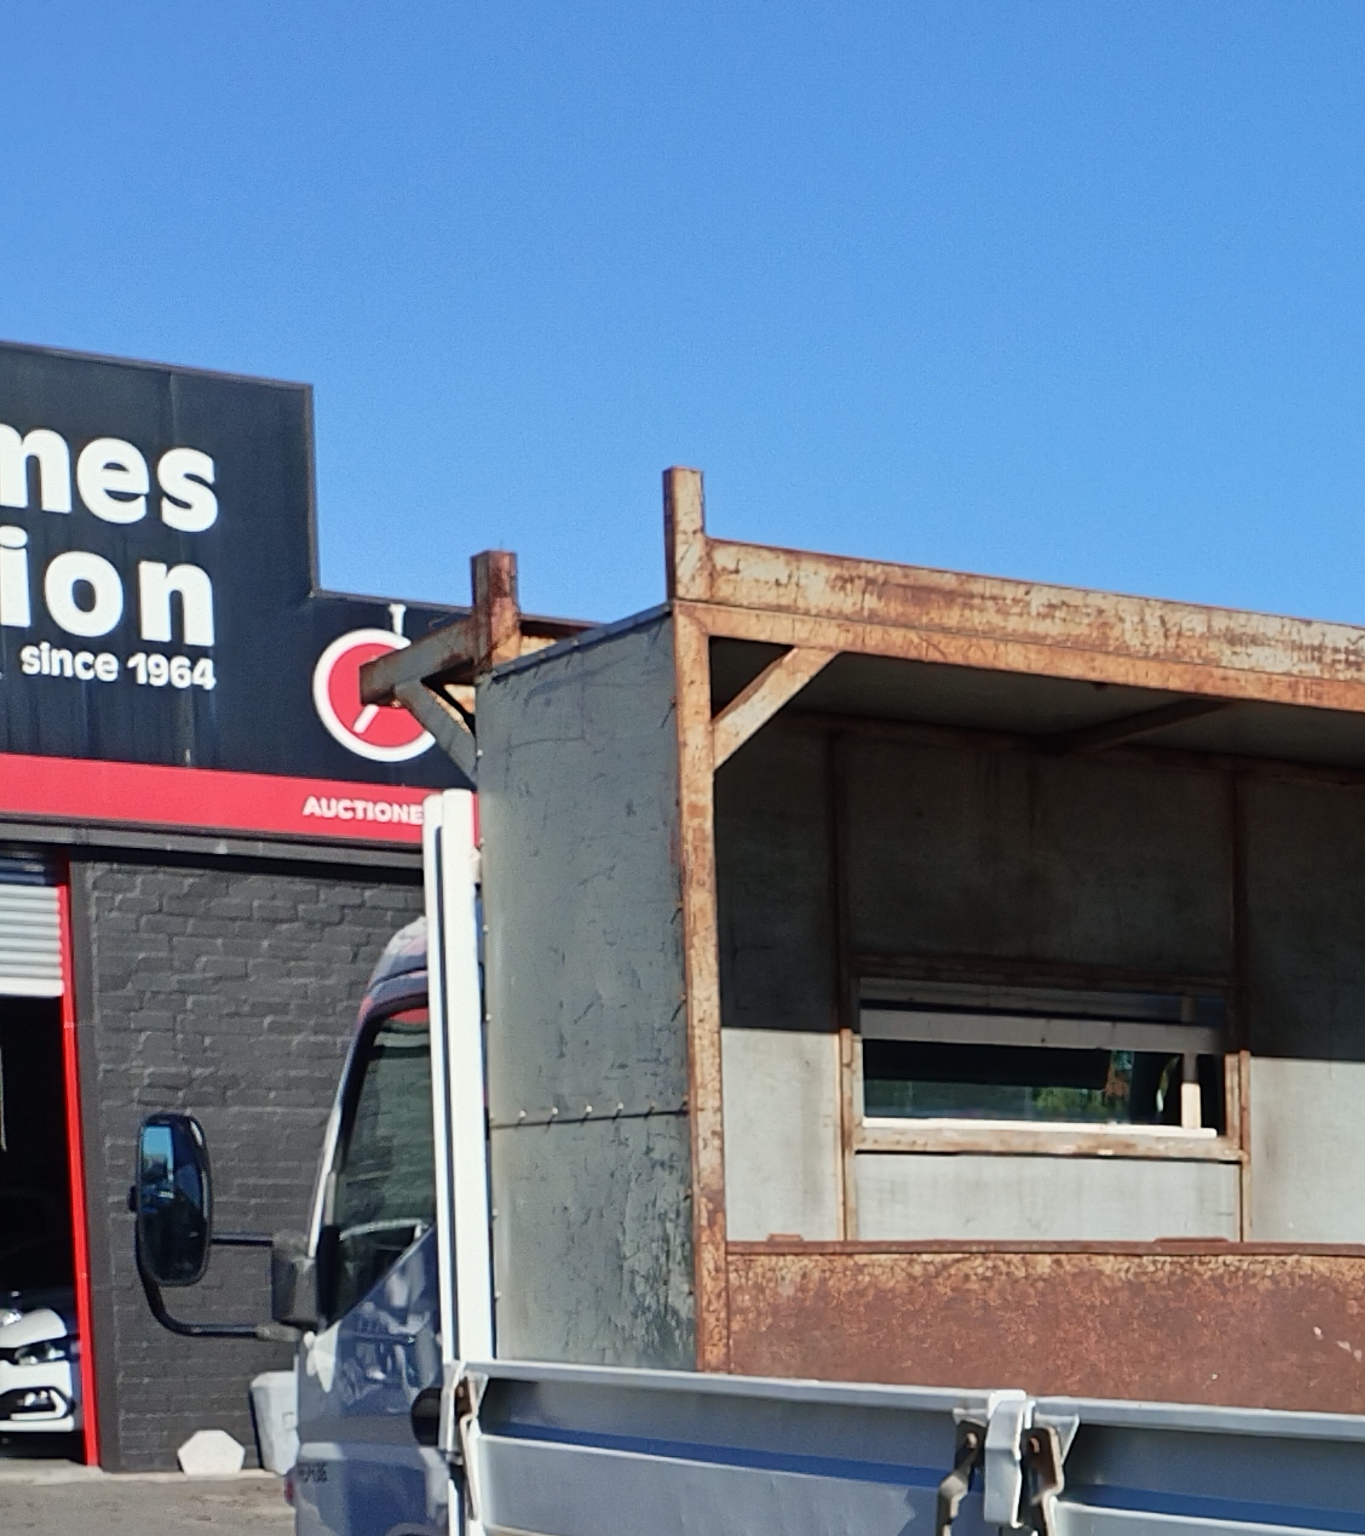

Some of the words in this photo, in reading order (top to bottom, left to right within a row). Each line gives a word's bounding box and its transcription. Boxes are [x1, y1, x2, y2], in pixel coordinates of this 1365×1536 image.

[20, 641, 119, 682] since
[127, 652, 217, 690] 1964
[303, 796, 423, 825] AUCTIONE
